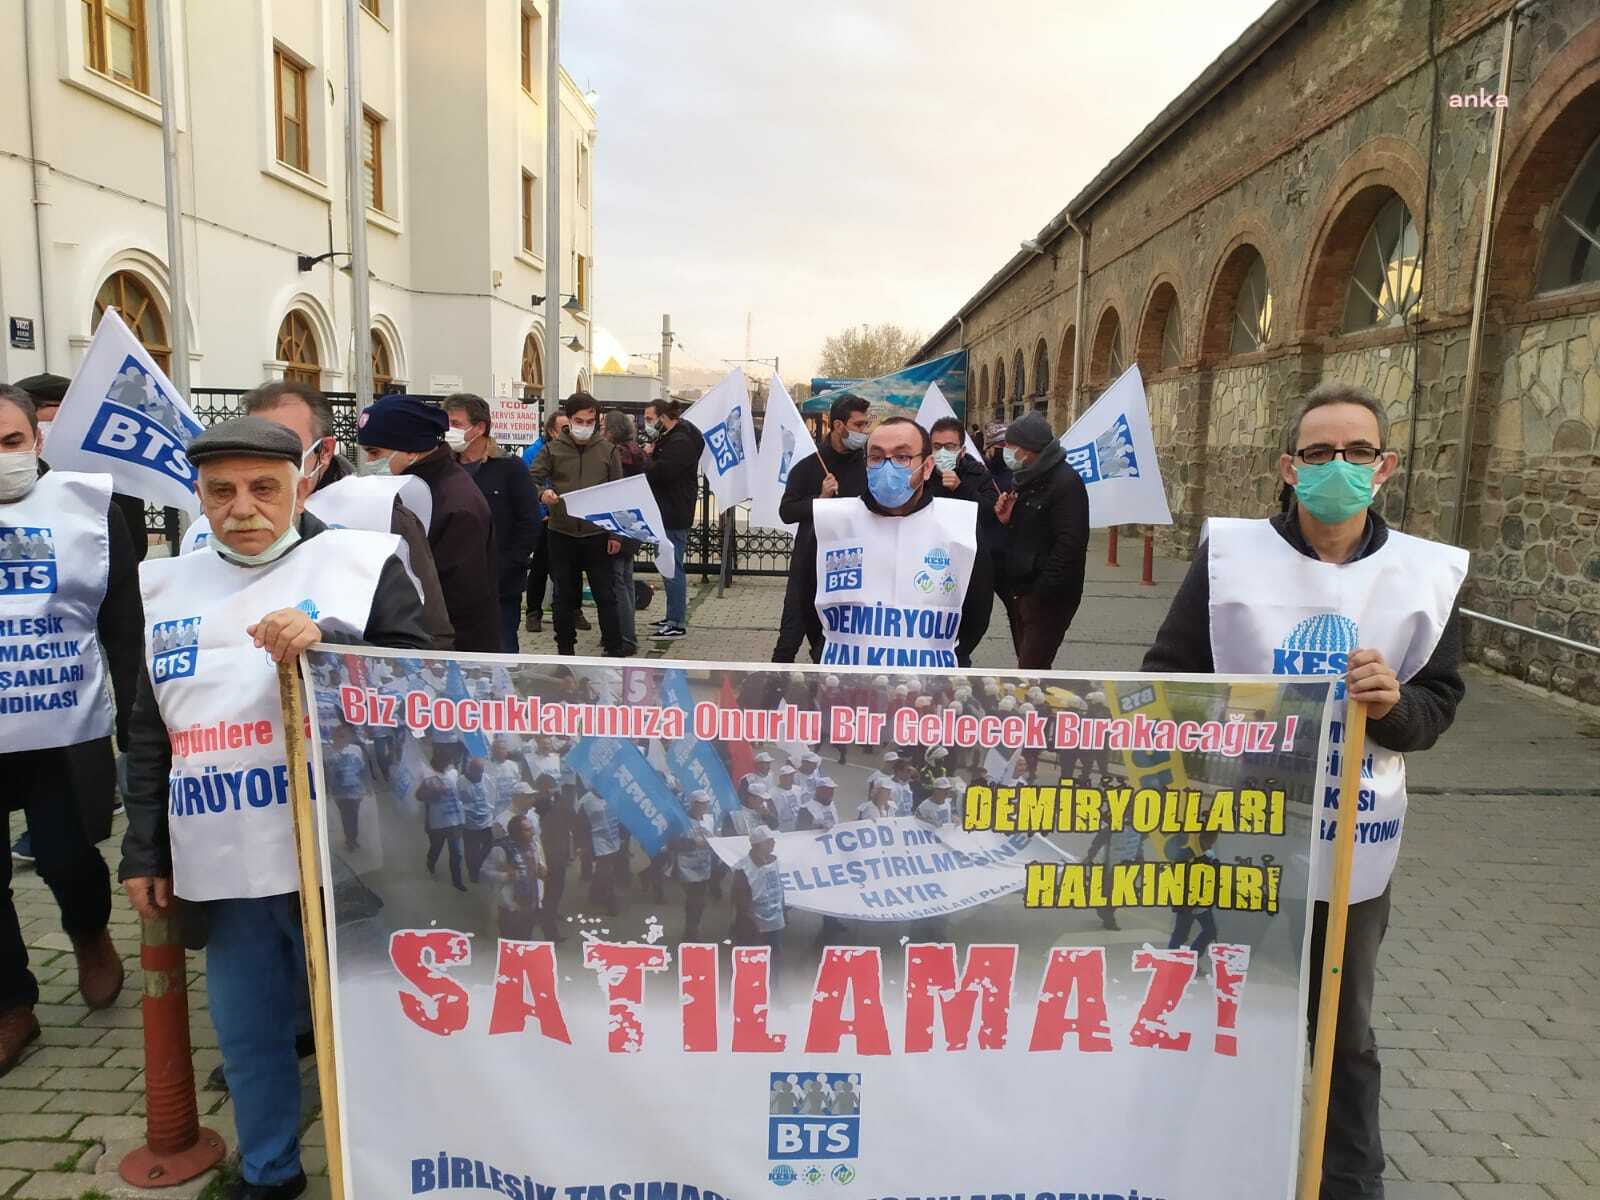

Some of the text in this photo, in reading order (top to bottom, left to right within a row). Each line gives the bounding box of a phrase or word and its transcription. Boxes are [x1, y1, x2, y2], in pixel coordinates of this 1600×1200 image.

[97, 412, 192, 479] BTS
[709, 427, 733, 469] BTS
[828, 572, 858, 589] BTS
[822, 601, 960, 640] DEMİRYOLU
[155, 652, 190, 679] BTS
[339, 686, 398, 728] Biz
[404, 690, 685, 740] Çocuklarımıza
[693, 700, 821, 744] Onurlu
[830, 705, 887, 745] Bir
[893, 706, 1048, 749] Gelecek
[1055, 710, 1278, 757] Bırakacağız
[962, 778, 1287, 836] DEMİRYOLLARI
[815, 825, 894, 856] TCDD
[859, 883, 947, 909] HAYIR
[1023, 860, 1282, 916] HALKINDIR!
[388, 926, 1252, 1057] SATILAMAZ!
[777, 1122, 850, 1154] BTS
